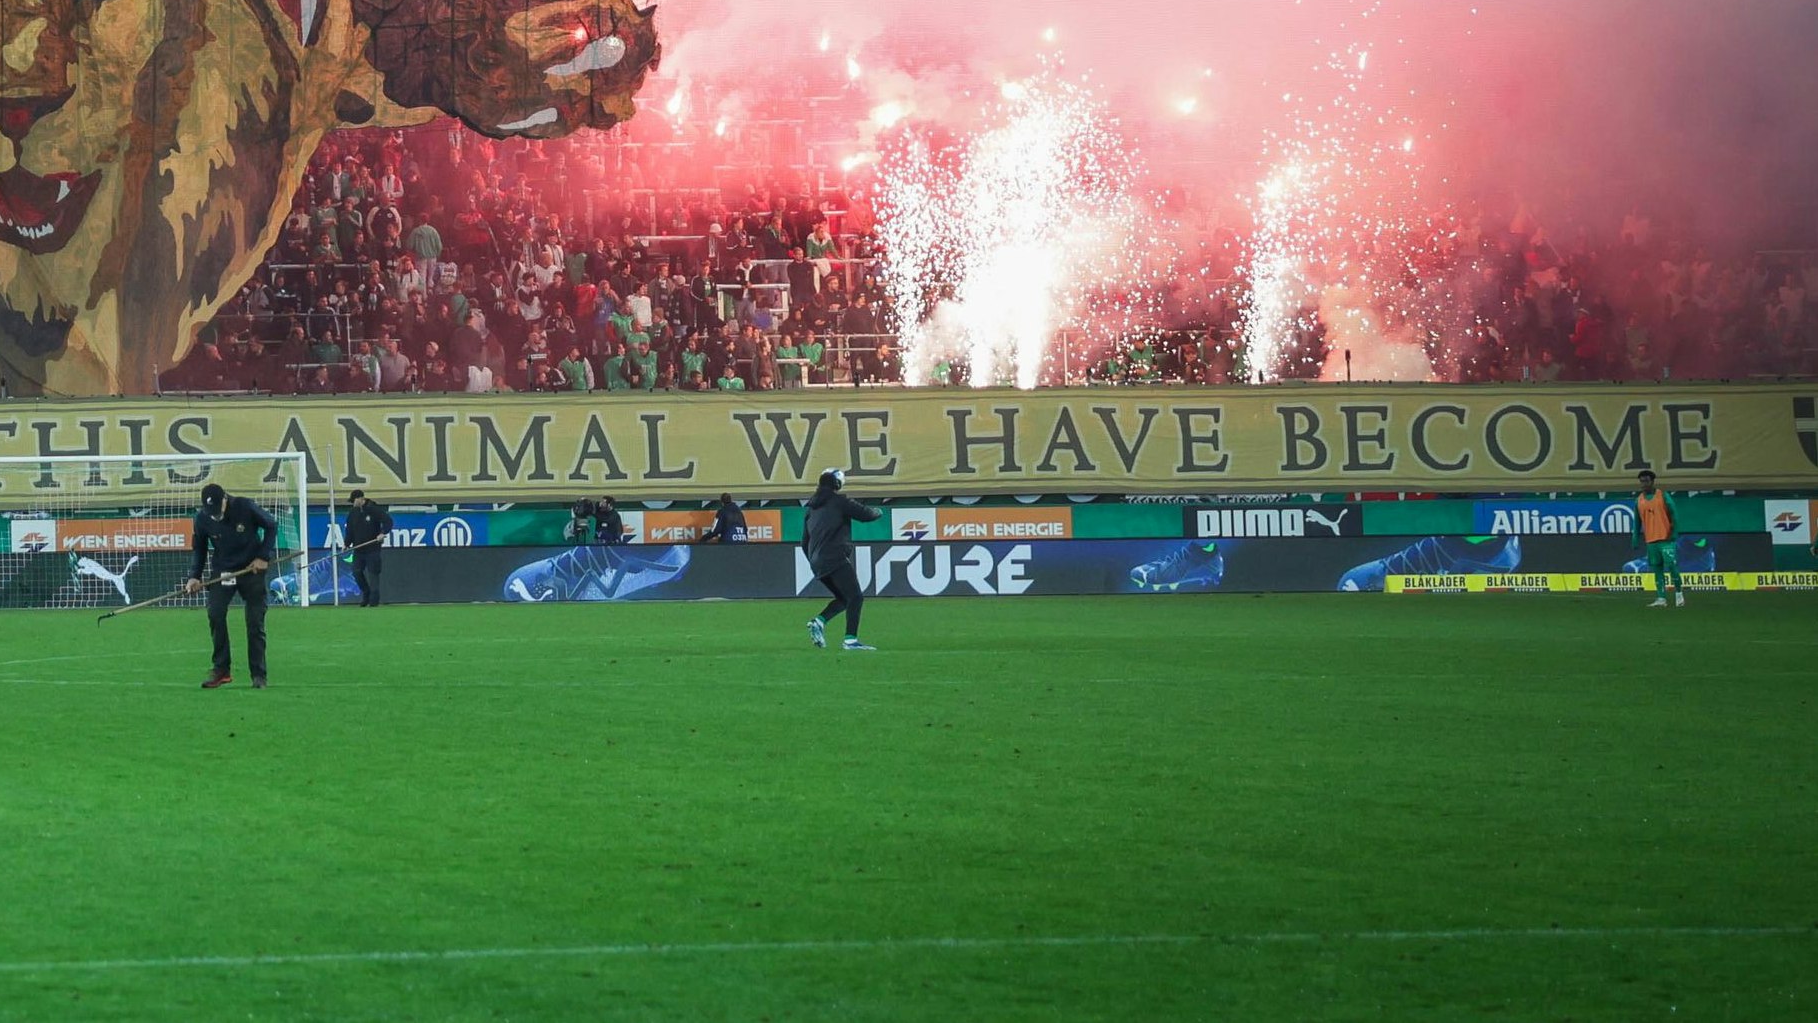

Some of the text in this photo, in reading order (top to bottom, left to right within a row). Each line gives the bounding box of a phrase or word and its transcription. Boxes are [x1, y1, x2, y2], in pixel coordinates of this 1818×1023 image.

[263, 413, 694, 484] ANIMAL
[732, 410, 898, 480] WE
[946, 406, 1229, 474] HAVE
[1277, 403, 1719, 473] BECOME
[650, 526, 773, 540] WIEN EGIE
[943, 522, 1064, 537] WIEN ENERGIE
[1196, 508, 1305, 537] PUMA
[1491, 510, 1594, 535] Allianz
[62, 534, 185, 549] WIEN ENERGIE
[323, 523, 426, 548] Aanz
